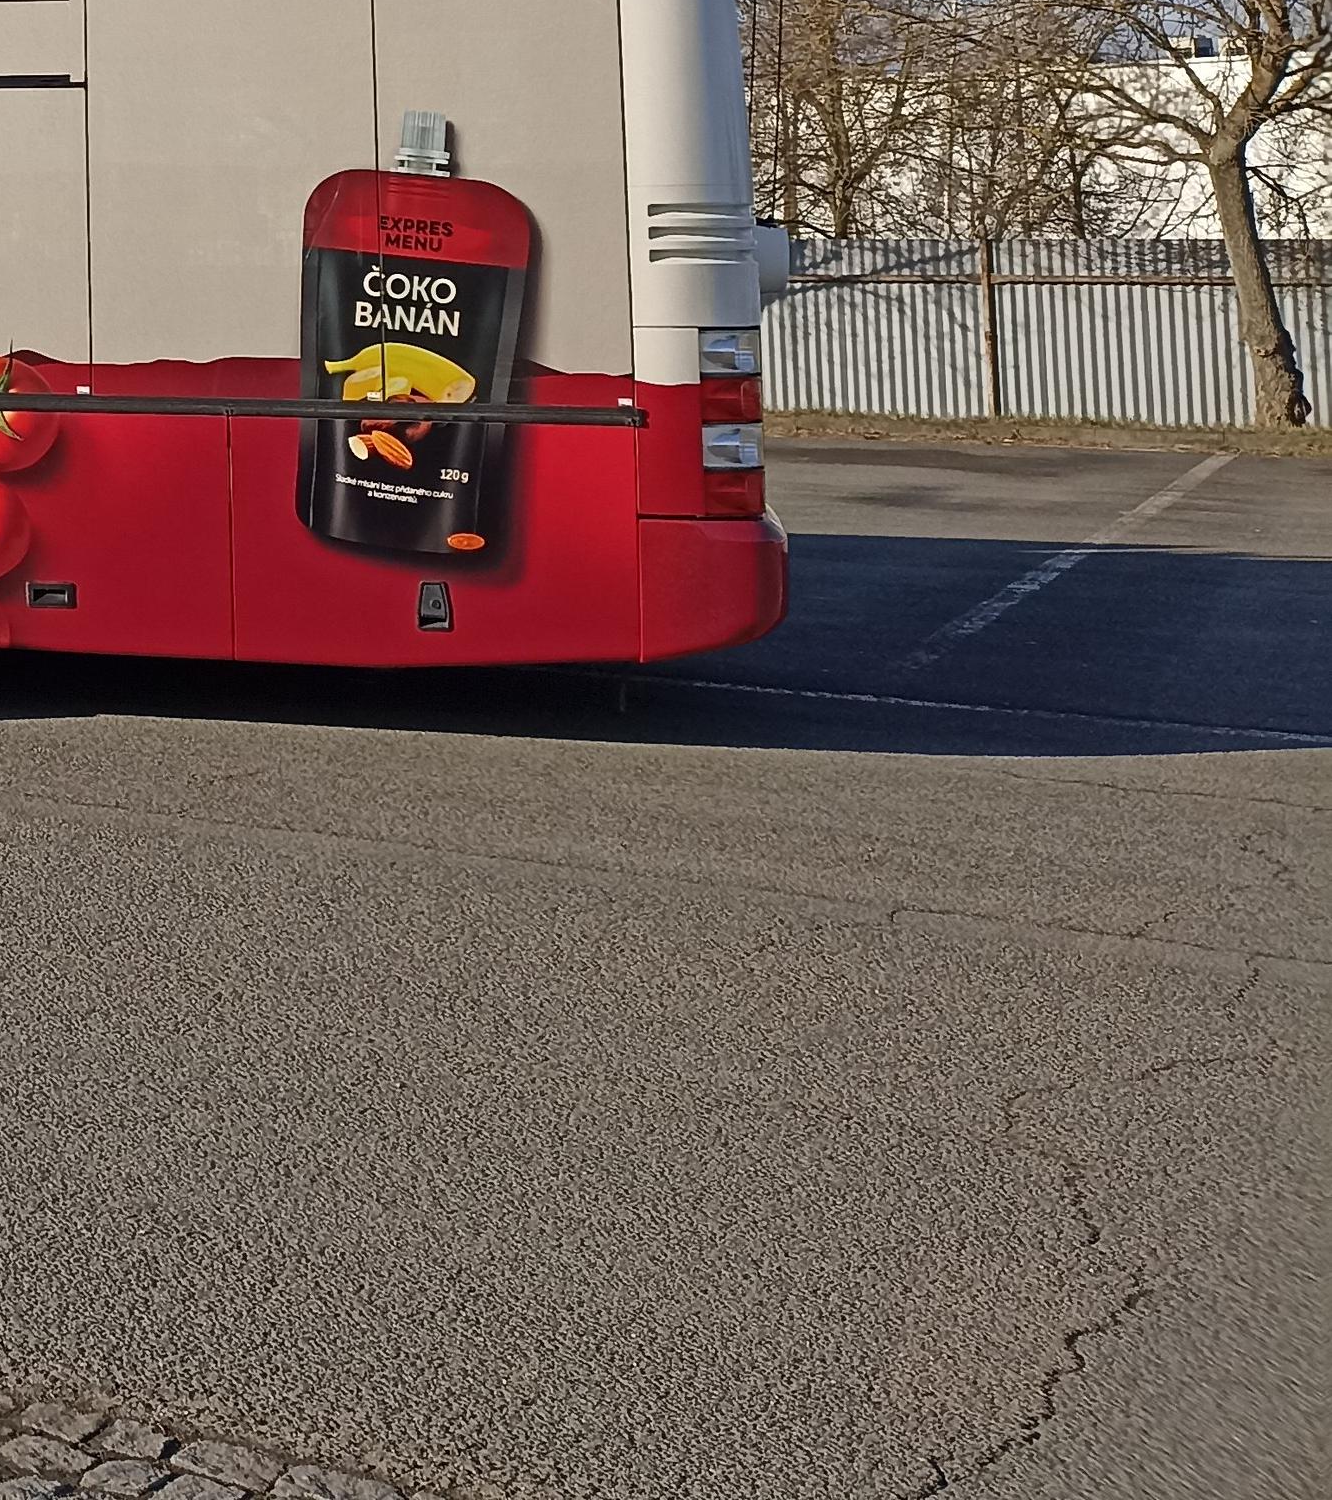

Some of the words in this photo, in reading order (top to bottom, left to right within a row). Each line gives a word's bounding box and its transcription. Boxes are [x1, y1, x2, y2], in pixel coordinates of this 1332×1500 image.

[379, 215, 454, 238] EXPRES
[385, 232, 443, 252] MENU
[363, 264, 457, 304] ČOKO
[354, 301, 460, 337] BANÁN
[439, 468, 460, 481] 120
[461, 471, 469, 483] g
